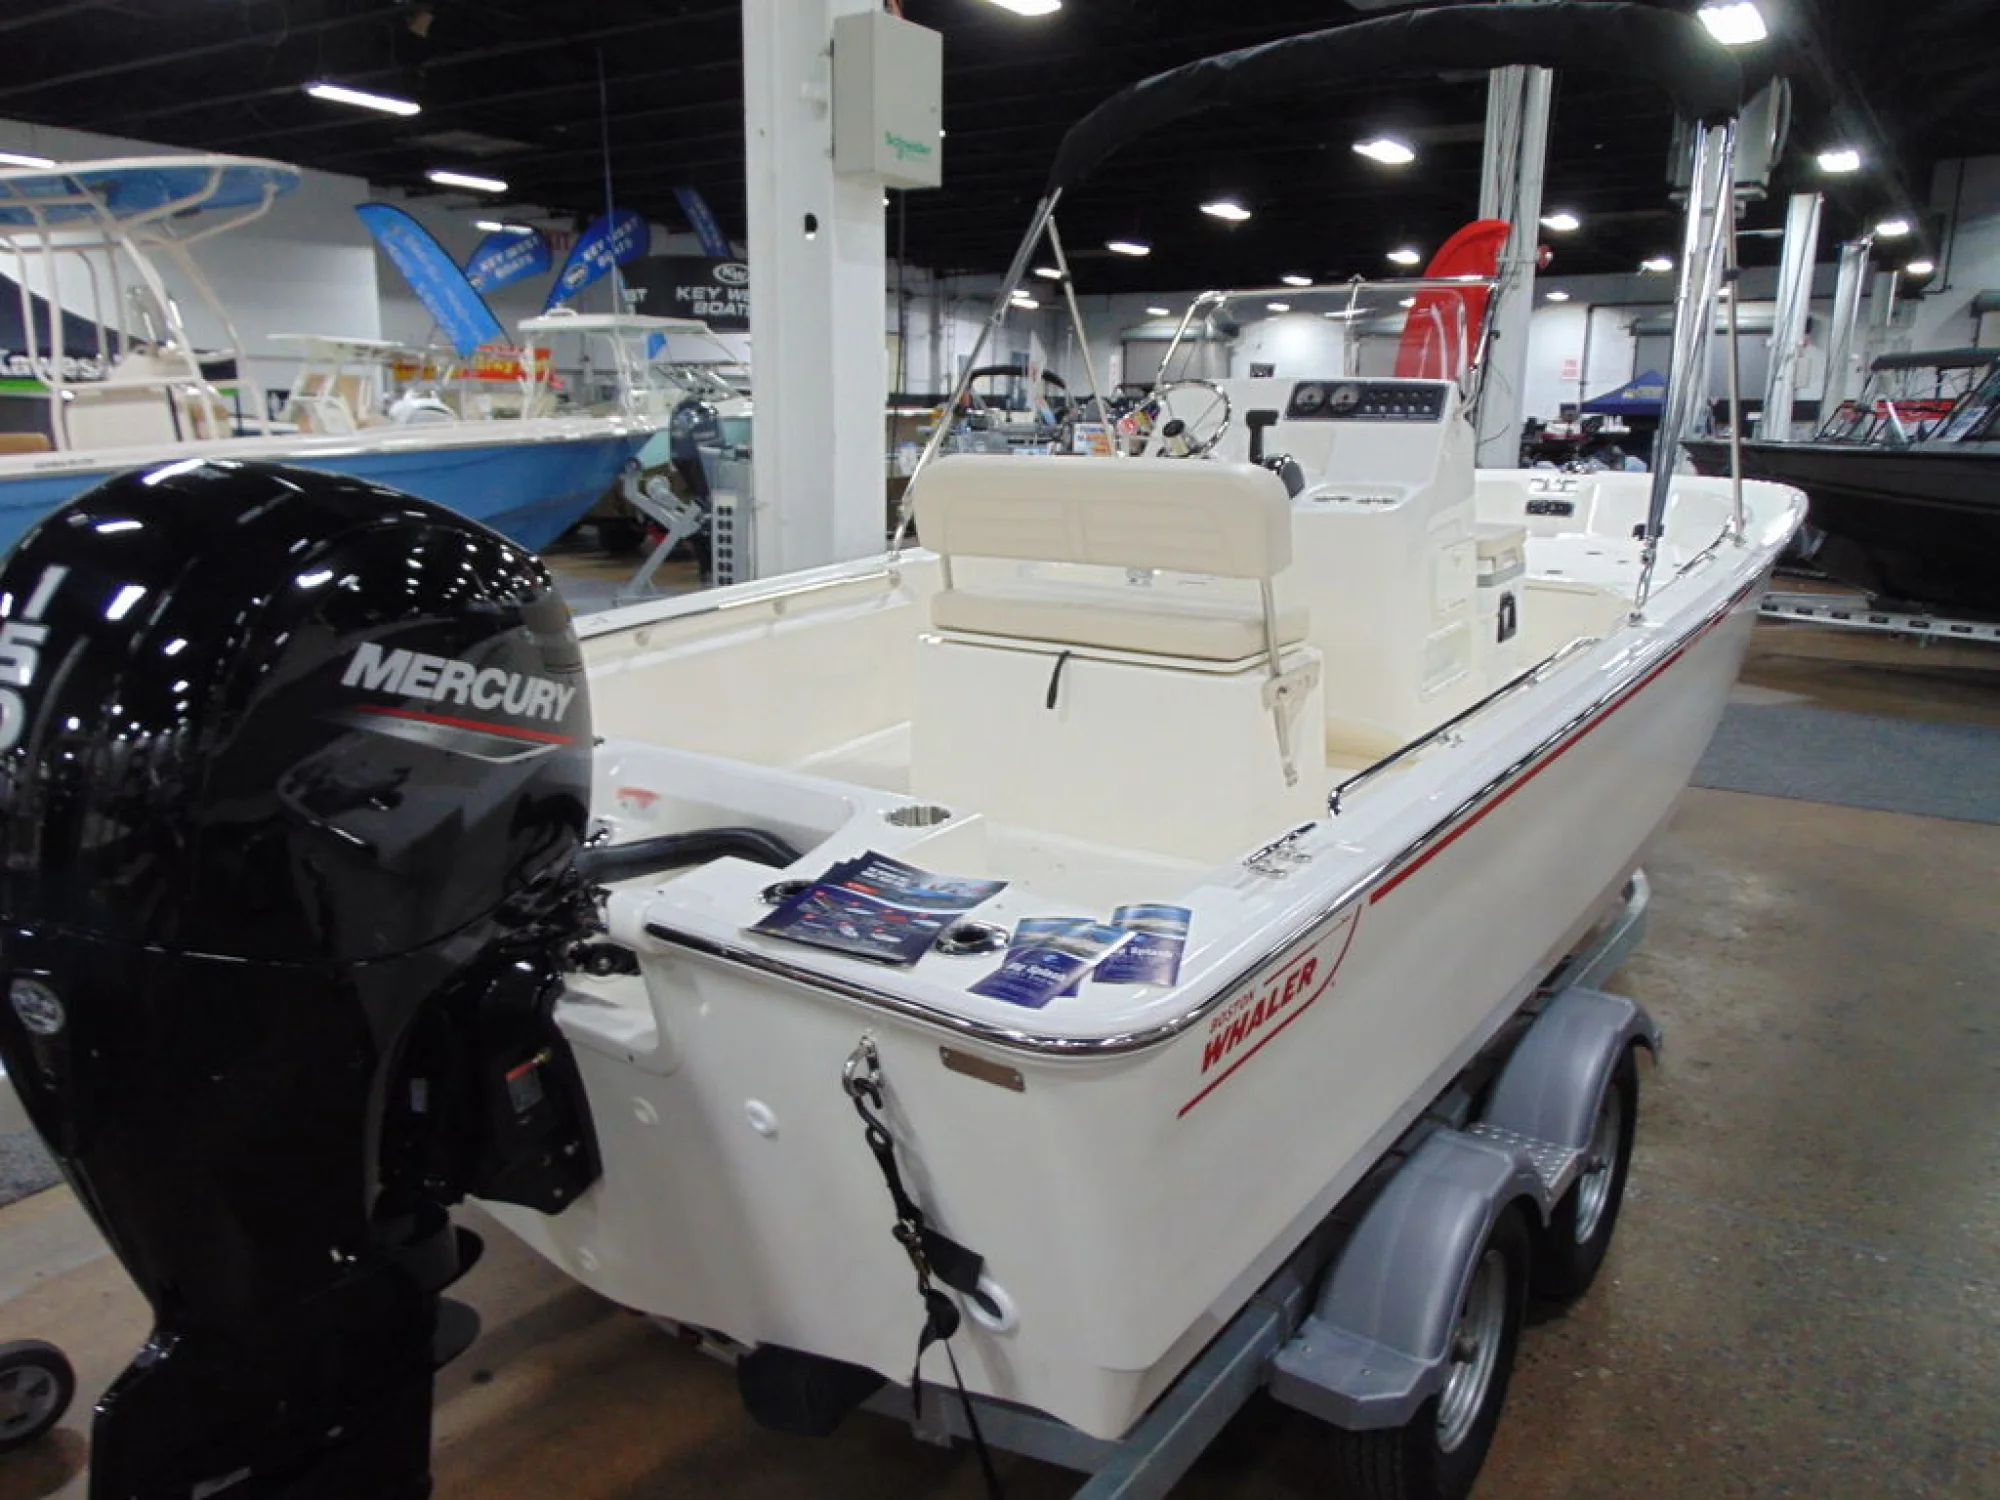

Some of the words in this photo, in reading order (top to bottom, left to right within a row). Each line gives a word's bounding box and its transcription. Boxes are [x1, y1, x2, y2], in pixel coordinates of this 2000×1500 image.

[675, 286, 722, 302] KEY
[727, 288, 749, 302] WE
[693, 301, 749, 317] BOAT
[341, 642, 577, 723] MERCURY
[1201, 956, 1317, 1073] WHALER
[1209, 989, 1254, 1034] BOSTON
